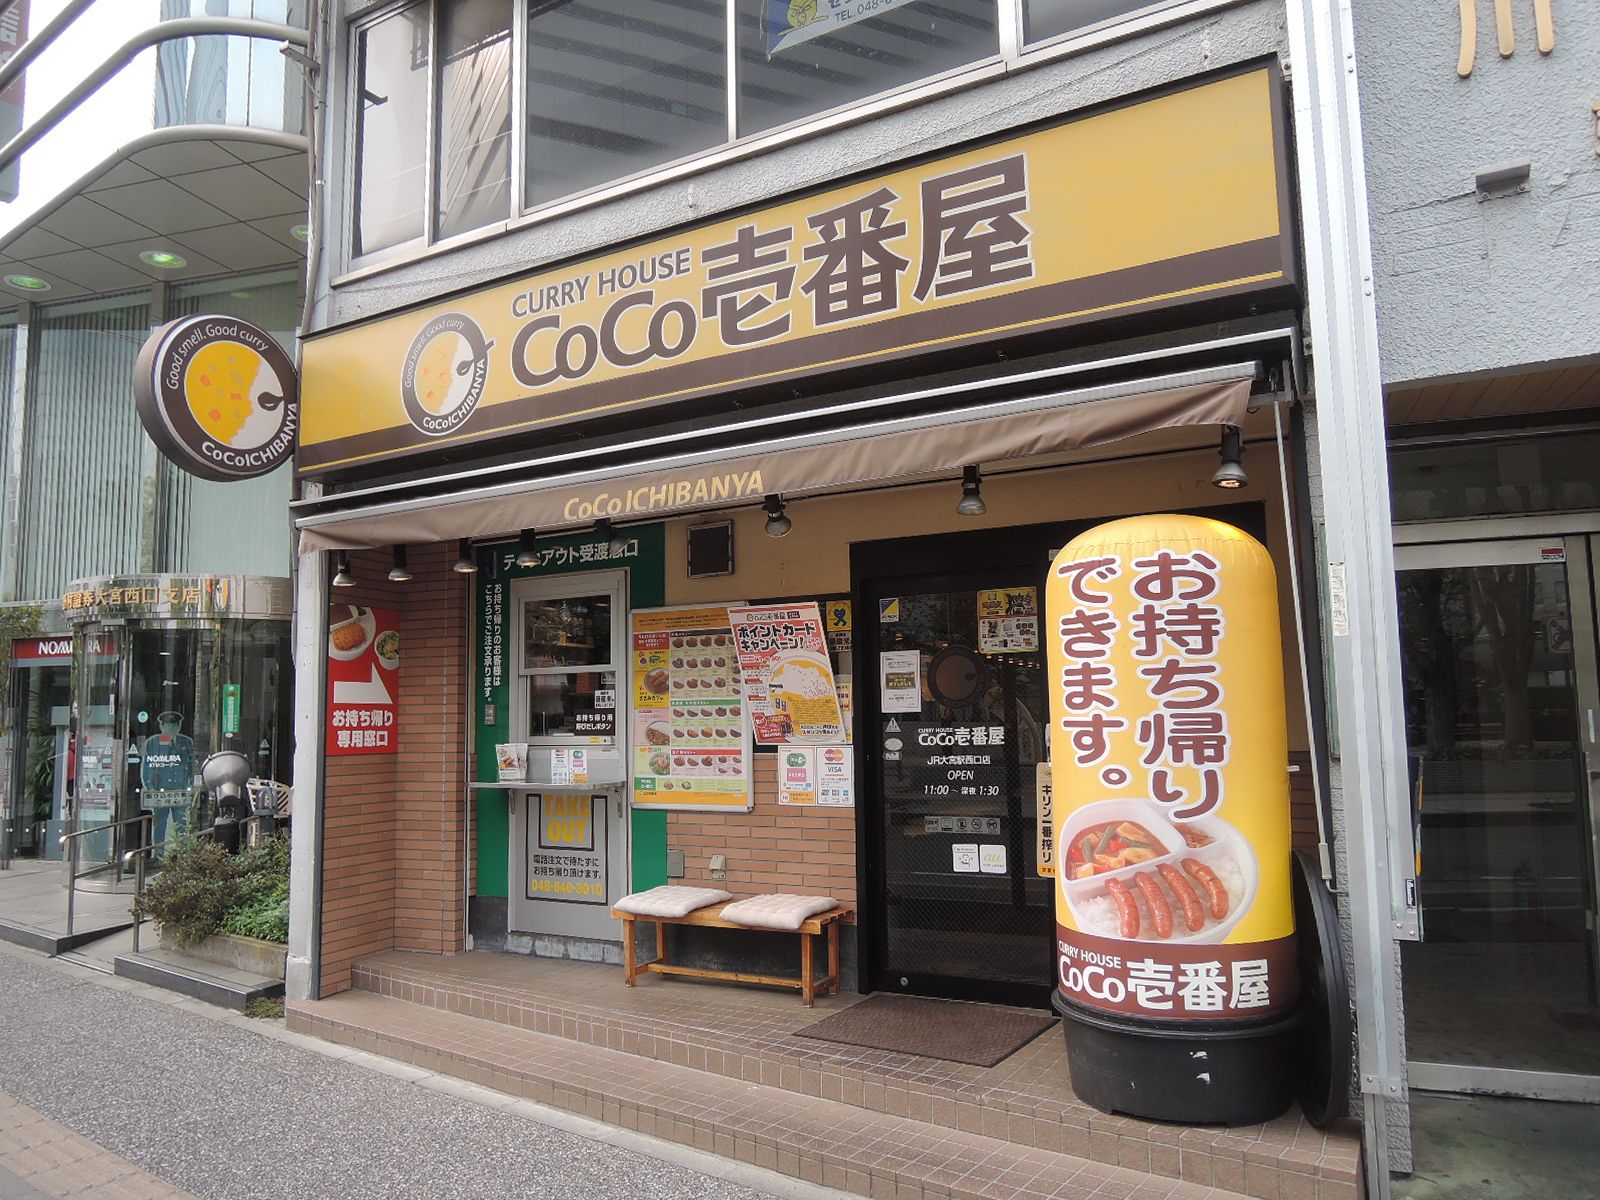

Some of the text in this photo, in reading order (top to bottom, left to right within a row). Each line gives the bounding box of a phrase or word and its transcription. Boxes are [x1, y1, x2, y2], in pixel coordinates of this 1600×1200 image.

[835, 9, 856, 22] TEL.
[508, 151, 1035, 390] CoCo壱番屋
[511, 246, 693, 318] CURRY HOUSE
[166, 351, 183, 390] Good
[206, 323, 238, 337] Good
[239, 330, 269, 352] curry
[423, 358, 485, 429] CoCoICHIBANYA
[503, 538, 639, 572] テアウト受渡口
[737, 621, 816, 639] ポイントカード
[1057, 556, 1129, 786] できます。
[1131, 550, 1229, 820] お持ち帰り
[332, 709, 393, 727] お持ち帰り
[575, 713, 613, 722] お持ち帰り用
[575, 722, 612, 731] 呼びだしボタン
[336, 730, 389, 748] 専用窓口
[918, 726, 1005, 746] CoCo壱番屋
[146, 755, 182, 763] NOMURA
[927, 755, 991, 765] JR大宮駅西口店
[947, 770, 975, 781] OPEN
[924, 785, 950, 795] 11:00
[961, 786, 977, 795] 深夜
[979, 785, 1000, 796] 1:30
[543, 793, 590, 818] TAKE
[547, 818, 587, 844] OUT
[1041, 784, 1053, 864] キリン一番搾り
[533, 854, 599, 867] 電話注文で待たずに
[1058, 939, 1122, 970] CURRY HOUSE
[1057, 956, 1271, 1012] CoCo壱番屋
